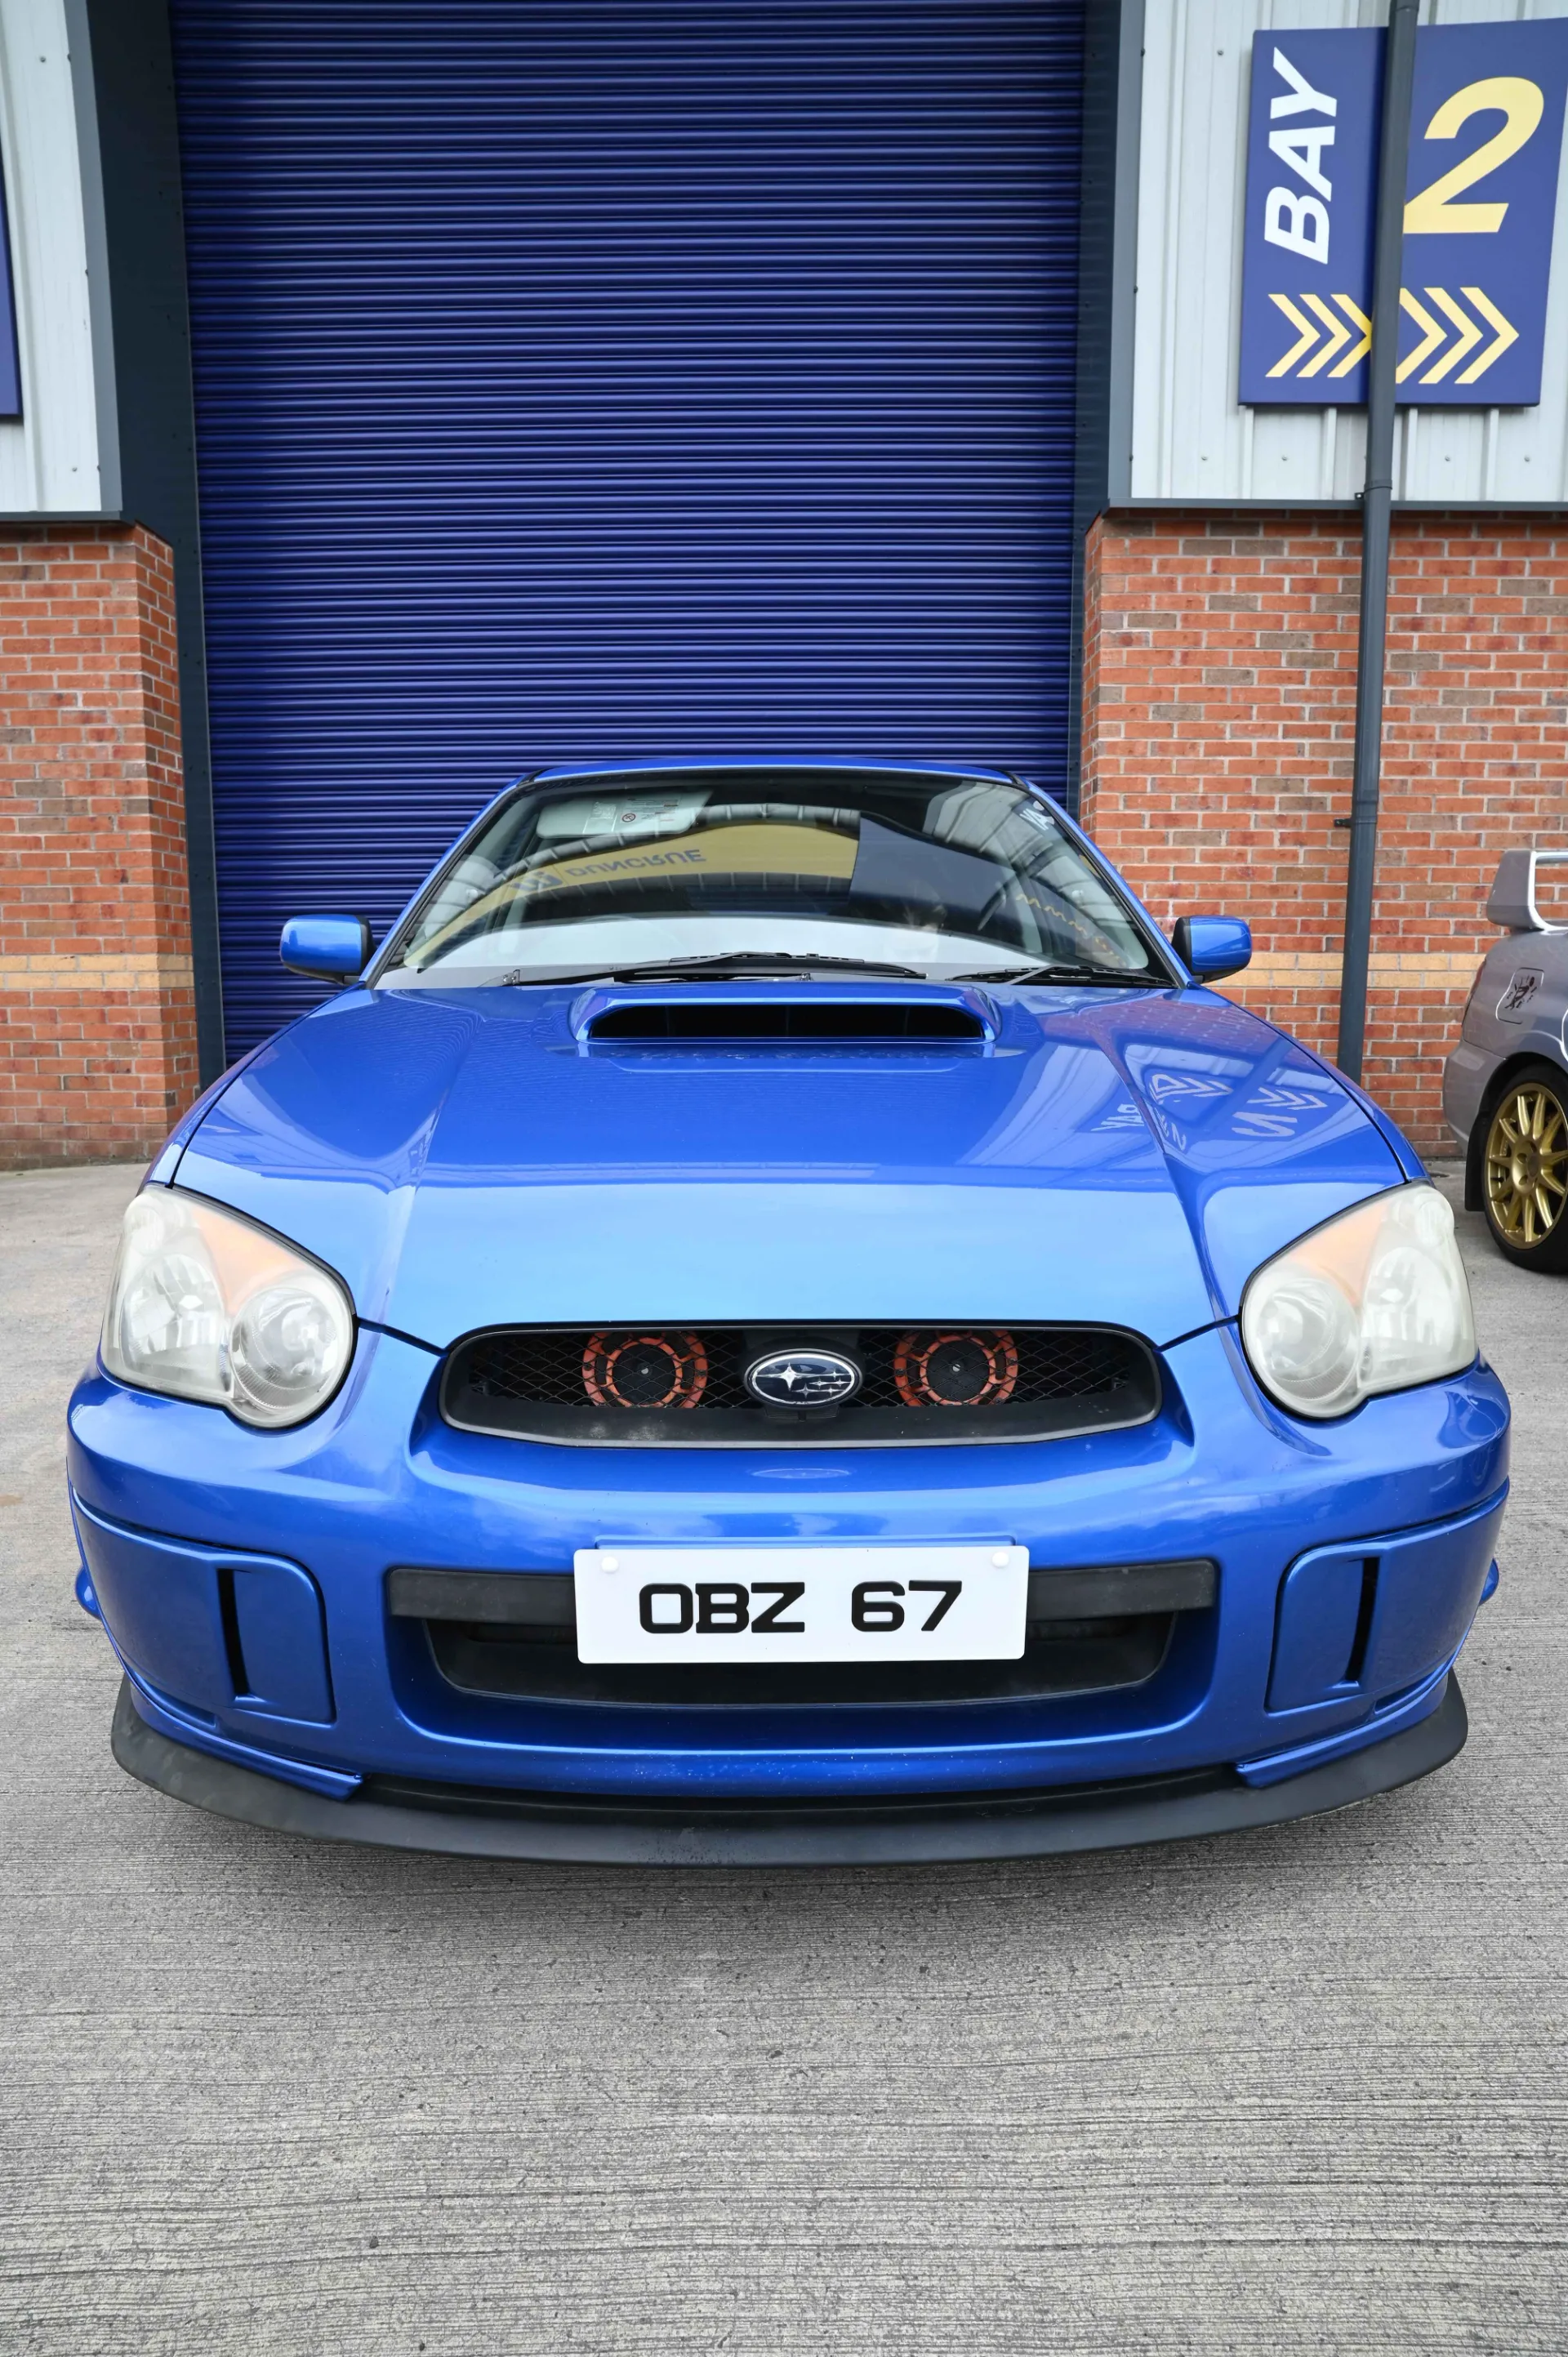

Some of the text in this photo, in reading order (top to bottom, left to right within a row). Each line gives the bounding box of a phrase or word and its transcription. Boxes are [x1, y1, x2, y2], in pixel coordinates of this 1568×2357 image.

[1264, 47, 1338, 265] BAY
[1402, 76, 1544, 234] 2
[639, 1580, 962, 1634] OBZ 67
